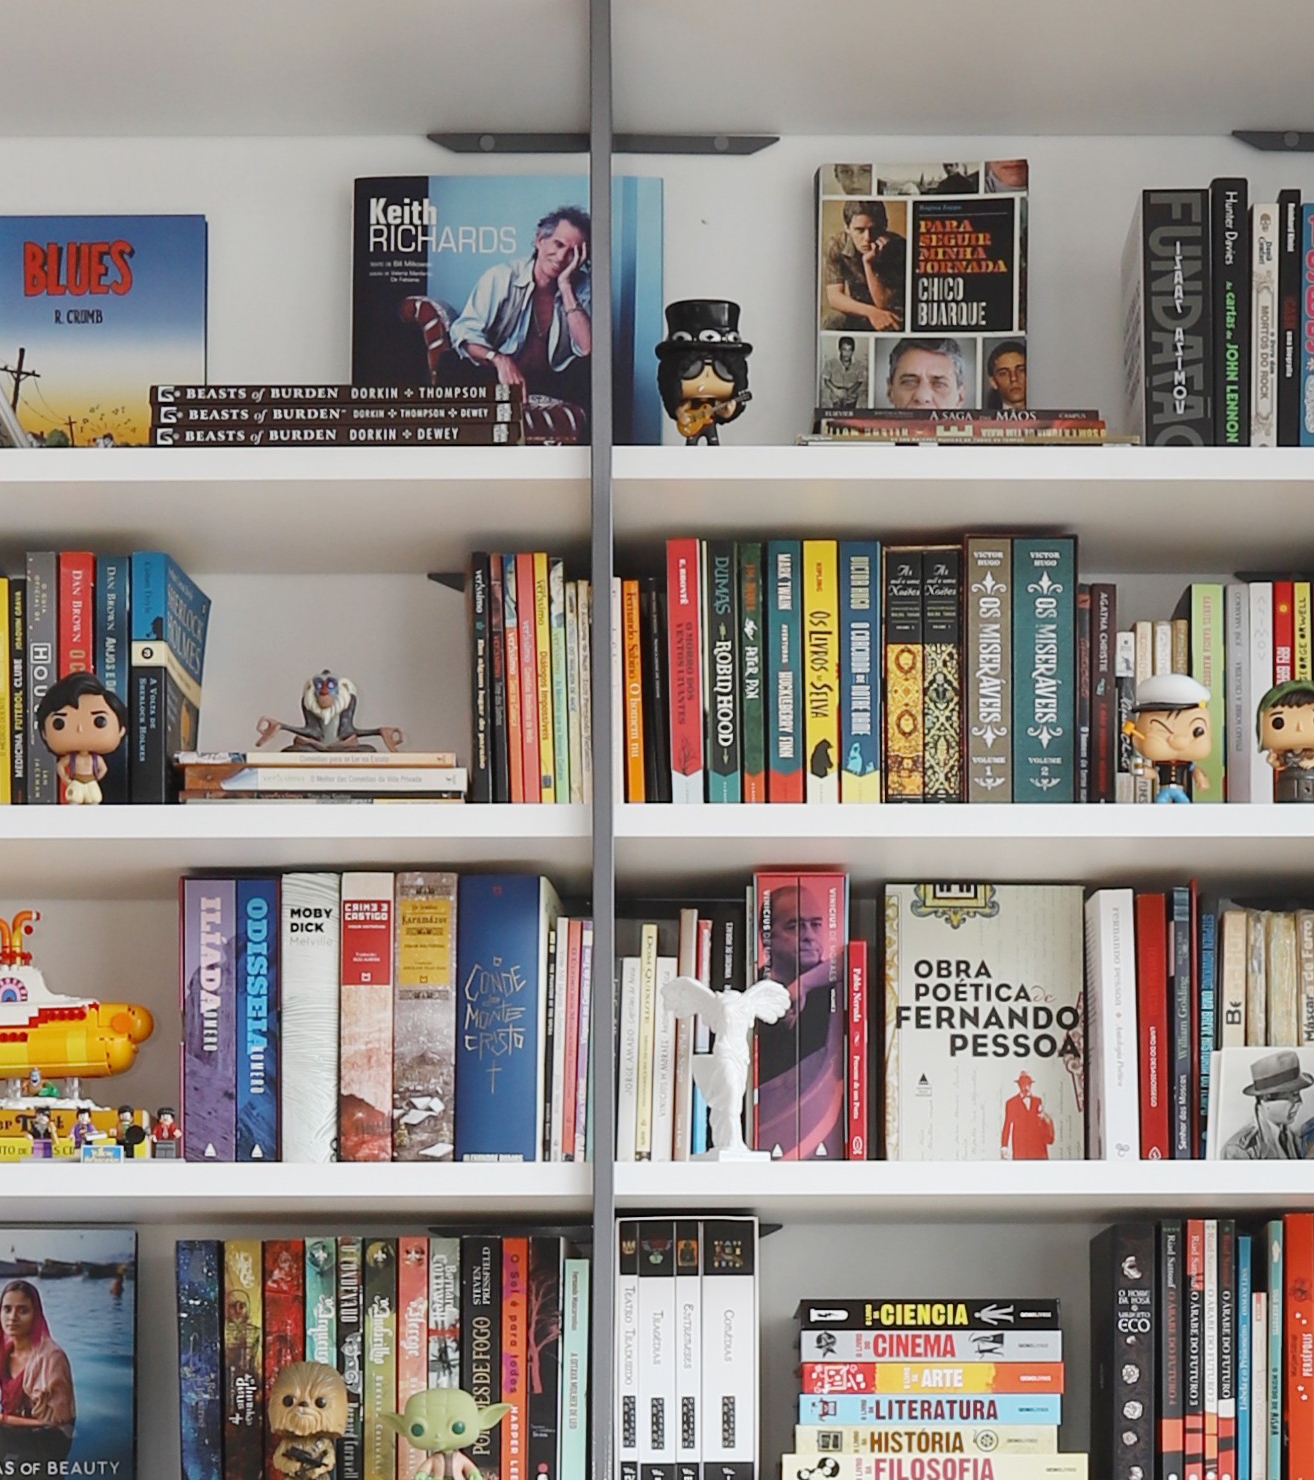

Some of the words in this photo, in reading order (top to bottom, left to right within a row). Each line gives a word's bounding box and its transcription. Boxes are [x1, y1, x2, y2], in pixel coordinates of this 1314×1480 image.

[370, 198, 437, 225] Keith
[919, 219, 973, 233] PARA
[370, 225, 516, 253] RICHARDS
[919, 232, 991, 247] SEGUIR
[918, 246, 986, 260] MINHA
[23, 240, 134, 297] BLUES
[915, 258, 1008, 274] JORNADA
[918, 277, 964, 302] CHICO
[918, 301, 987, 326] BUARQUE
[1226, 342, 1239, 382] JOHN
[187, 387, 247, 400] BEASTS
[251, 387, 266, 402] of
[270, 387, 339, 399] BURDEN
[350, 387, 398, 400] DORKIN
[419, 387, 487, 400] THOMPSON
[1225, 386, 1238, 443] LENNON
[777, 554, 792, 578] MARK
[72, 570, 82, 595] DAN
[713, 556, 730, 615] DUMAS
[777, 581, 791, 611] TWAIN
[980, 597, 1001, 618] OS
[1035, 597, 1057, 618] OS
[72, 600, 82, 642] BROWN
[714, 639, 733, 693] ROBIN
[976, 623, 1006, 723] MISERÁVEIS
[1032, 623, 1062, 723] MISERÁVEIS
[809, 682, 833, 719] SELVA
[716, 695, 734, 747] HOOD
[290, 907, 333, 919] MOBY
[290, 922, 325, 933] DICK
[199, 897, 226, 1016] ILÍADA
[914, 959, 992, 979] OBRA
[246, 897, 268, 1054] ODISSEIA
[464, 963, 527, 1001] CONDE
[914, 979, 1032, 1002] POÉTICA
[464, 1001, 526, 1030] MONTE
[895, 1006, 1079, 1030] FERNANDO
[464, 1027, 526, 1061] CRISTO
[949, 1033, 1082, 1058] PESSOA
[873, 1333, 956, 1357] CINEMA
[1301, 1333, 1314, 1377] PERSÉPOLIS
[921, 1368, 963, 1388] ARTE
[875, 1399, 998, 1420] LITERATURA
[510, 1406, 519, 1454] HARPER
[869, 1428, 965, 1453] HISTÓRIA
[20, 1462, 41, 1475] OF
[48, 1461, 120, 1475] BEAUTY
[510, 1460, 519, 1480] LEE
